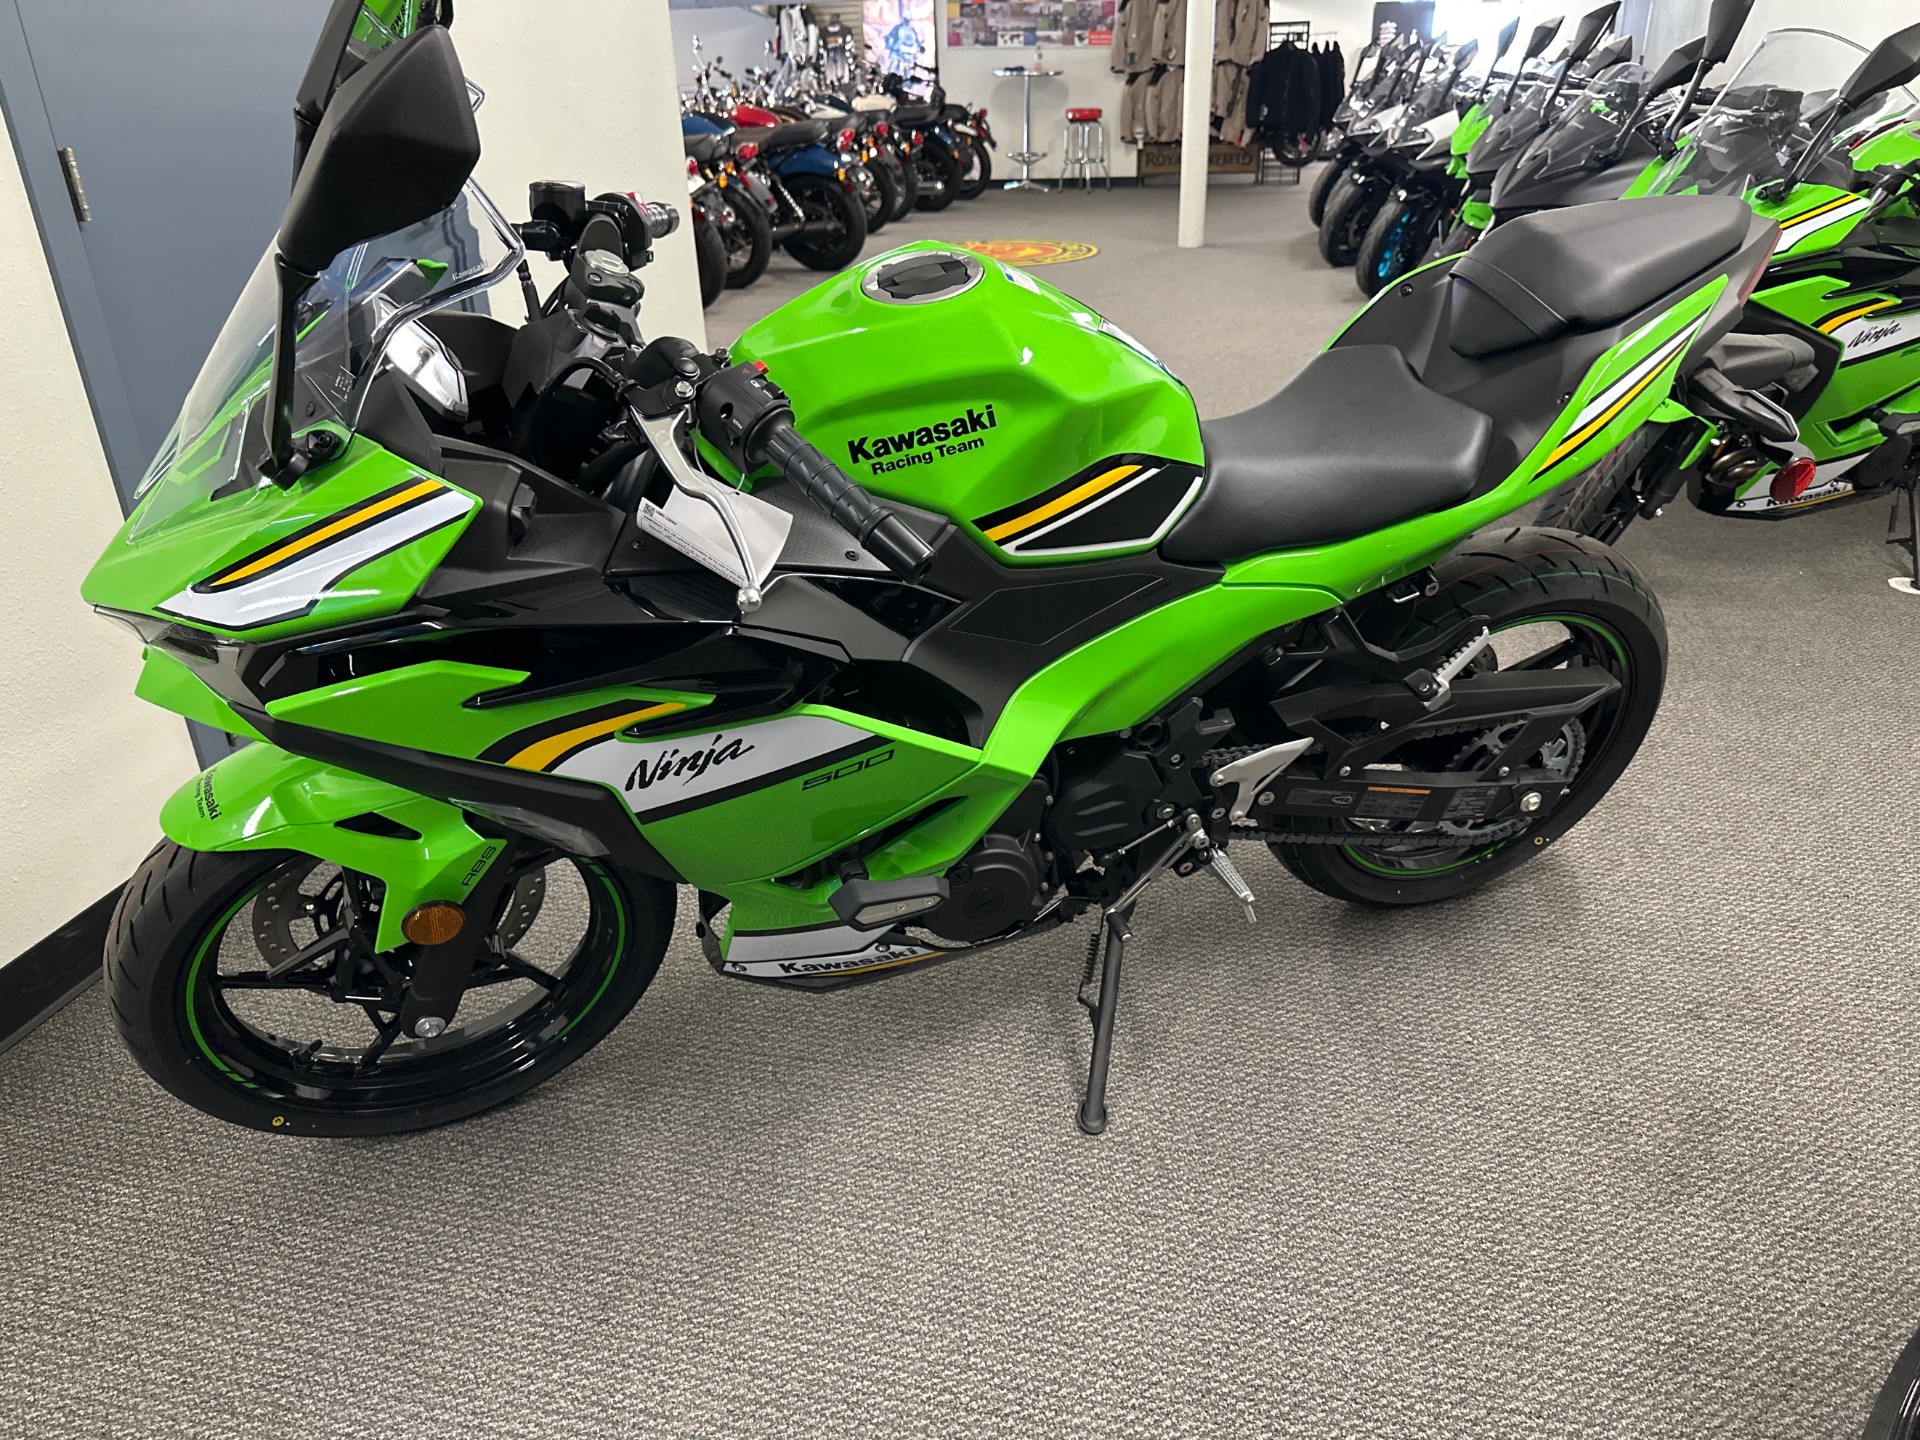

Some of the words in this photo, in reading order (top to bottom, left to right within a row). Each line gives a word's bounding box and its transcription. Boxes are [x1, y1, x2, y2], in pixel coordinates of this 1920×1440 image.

[1847, 320, 1902, 348] Ninja
[848, 404, 997, 464] Kawasaki
[871, 451, 933, 475] Racing
[935, 437, 985, 458] Team
[624, 734, 755, 791] Ninja
[802, 749, 895, 791] 500
[196, 797, 205, 818] Team
[461, 846, 497, 886] ABS
[778, 947, 918, 974] Kawasaki
